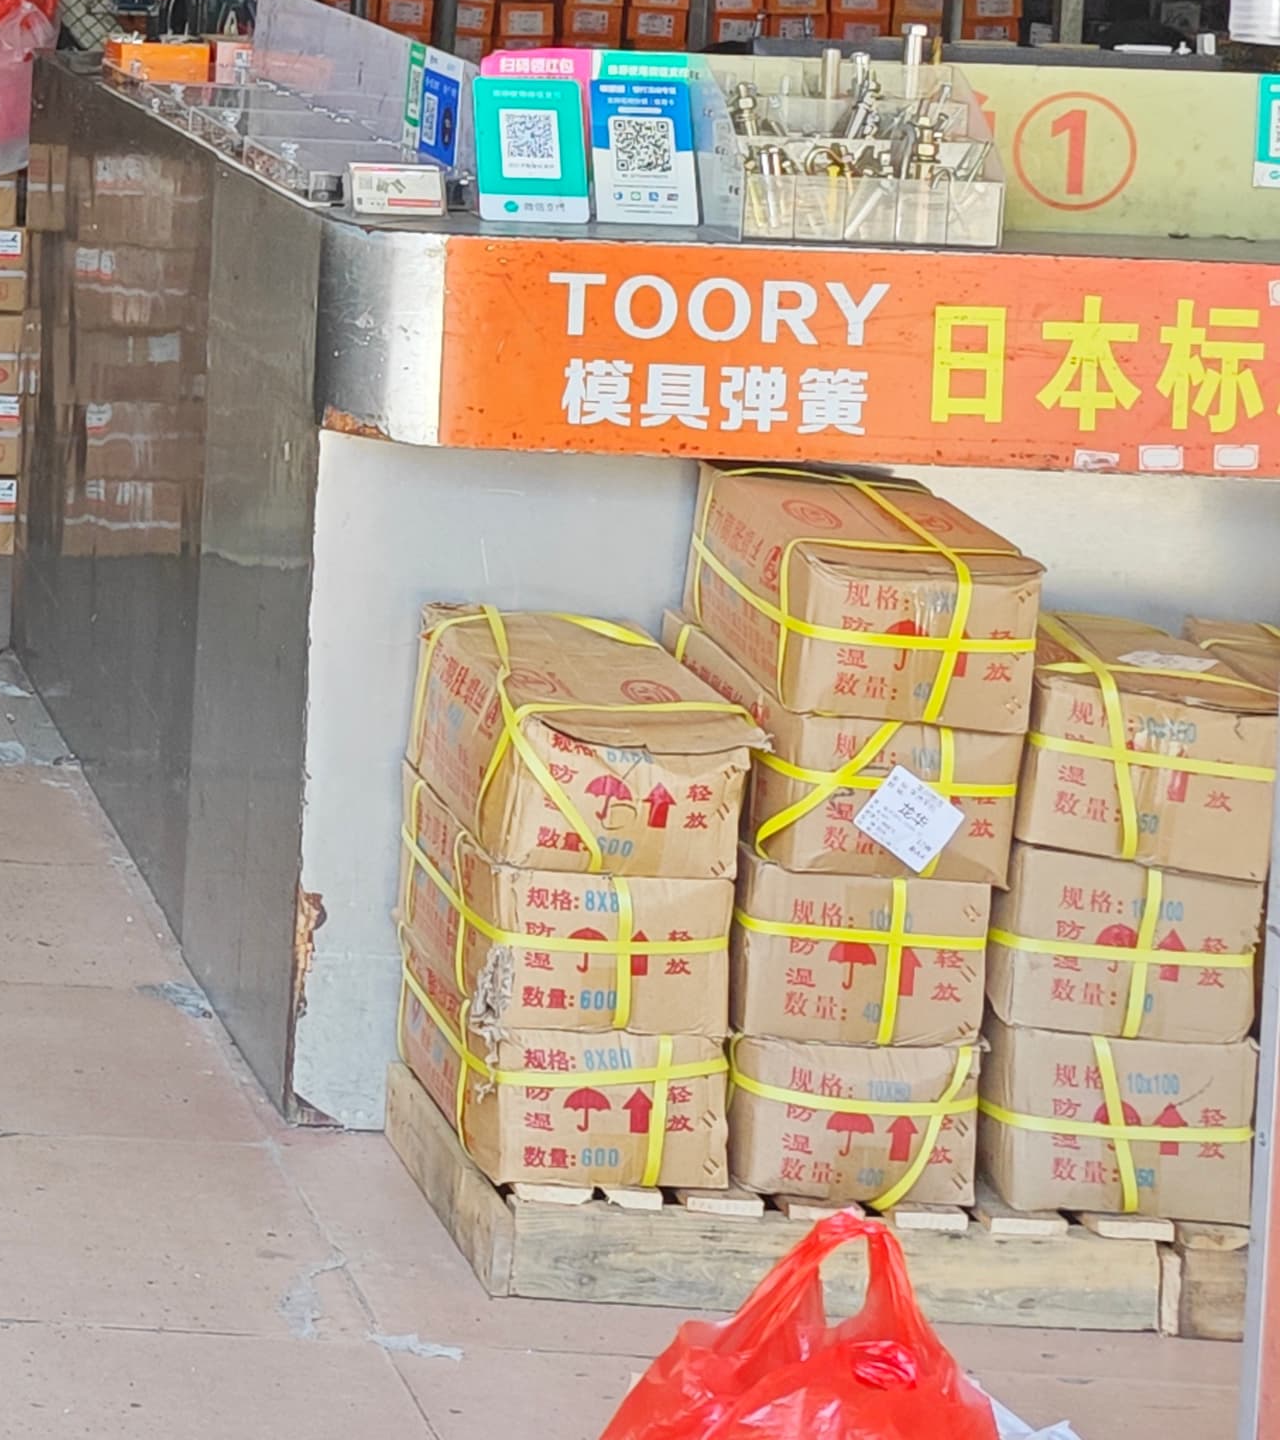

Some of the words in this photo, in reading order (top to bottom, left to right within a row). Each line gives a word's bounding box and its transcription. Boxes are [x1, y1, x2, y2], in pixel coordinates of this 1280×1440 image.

[548, 271, 891, 347] TOORY
[561, 358, 869, 436] 模具弹簧
[931, 295, 1280, 433] 日本标
[522, 985, 575, 1010] 数量:
[523, 1146, 577, 1170] 数量:
